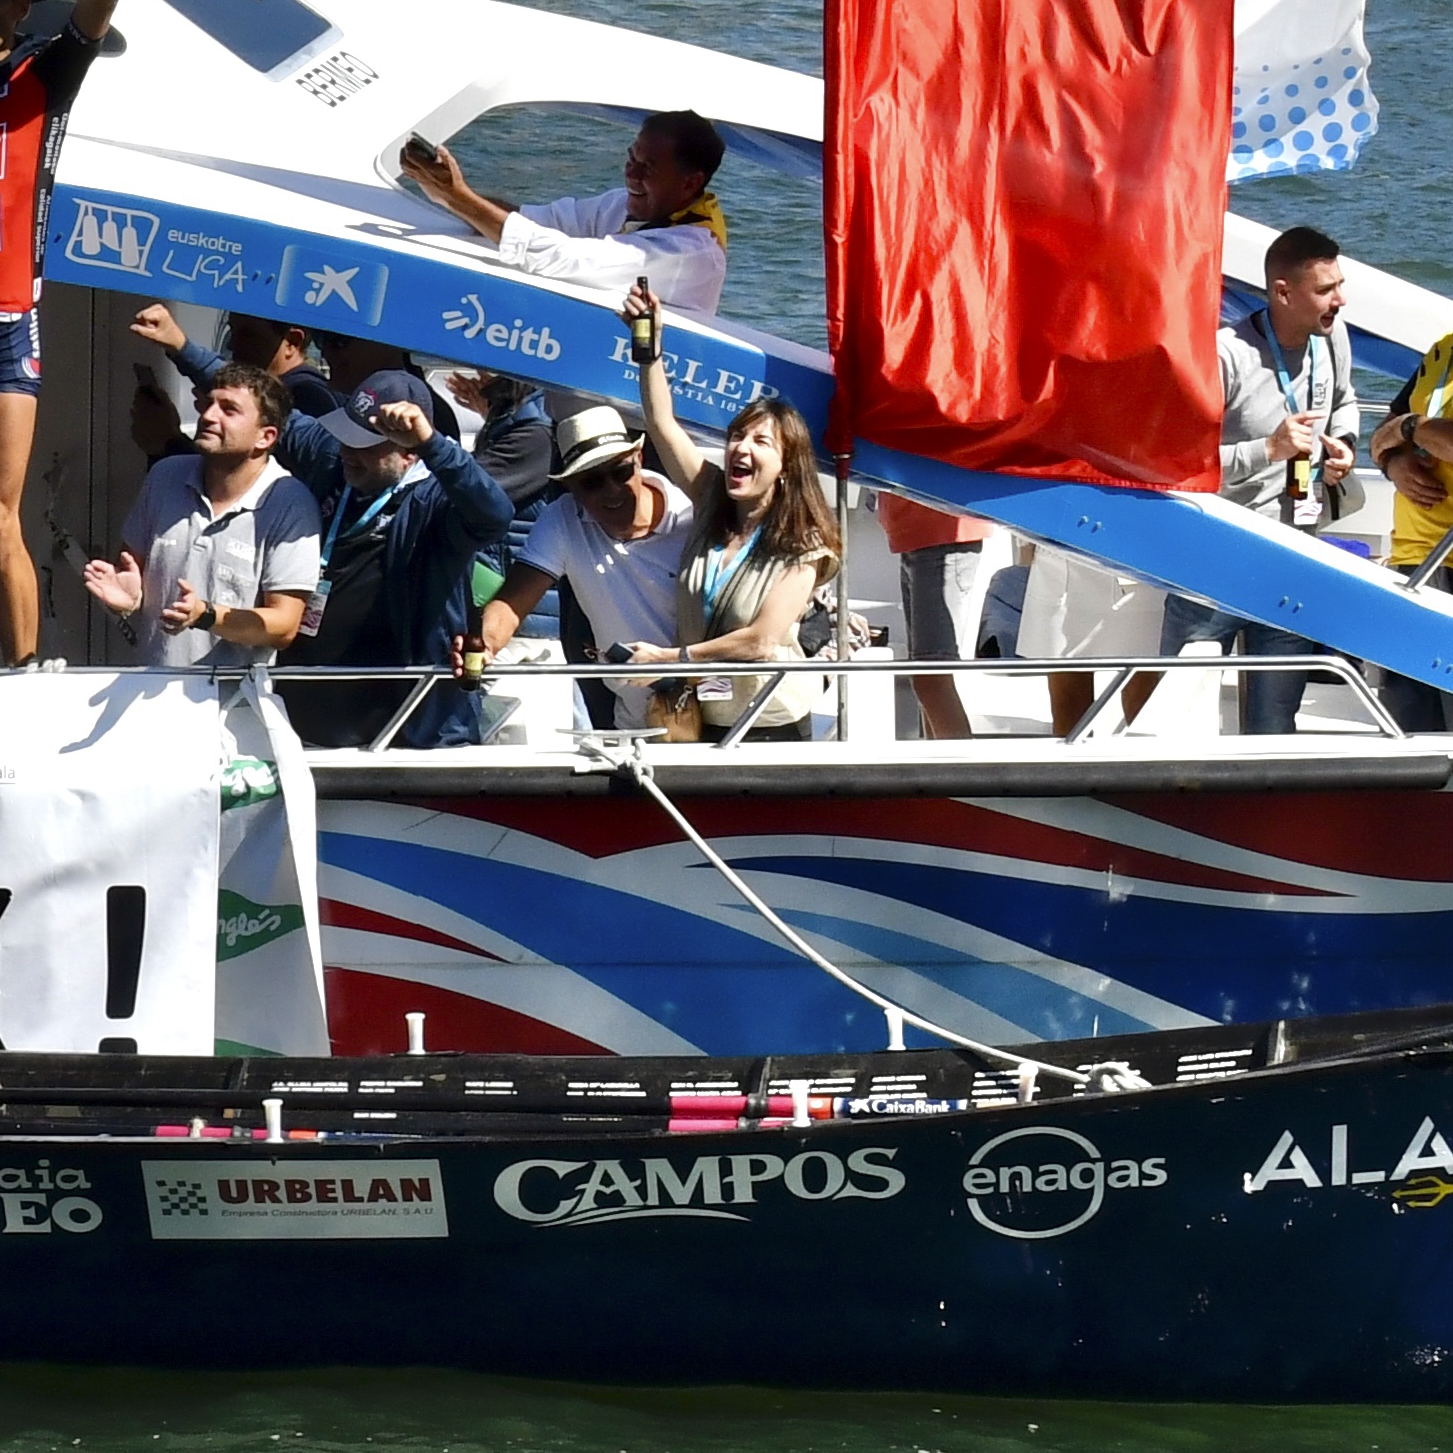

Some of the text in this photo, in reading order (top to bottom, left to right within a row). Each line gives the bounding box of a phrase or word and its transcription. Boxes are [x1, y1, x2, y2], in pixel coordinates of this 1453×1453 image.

[296, 51, 379, 107] BERMEO
[162, 249, 249, 294] LIGA
[485, 317, 562, 362] eitb
[871, 1097, 951, 1115] CaixaBank
[217, 1176, 433, 1206] URBELAN
[494, 1148, 906, 1224] CAMPOS
[962, 1157, 1169, 1200] enagas
[221, 1207, 339, 1219] Empresa Constructora
